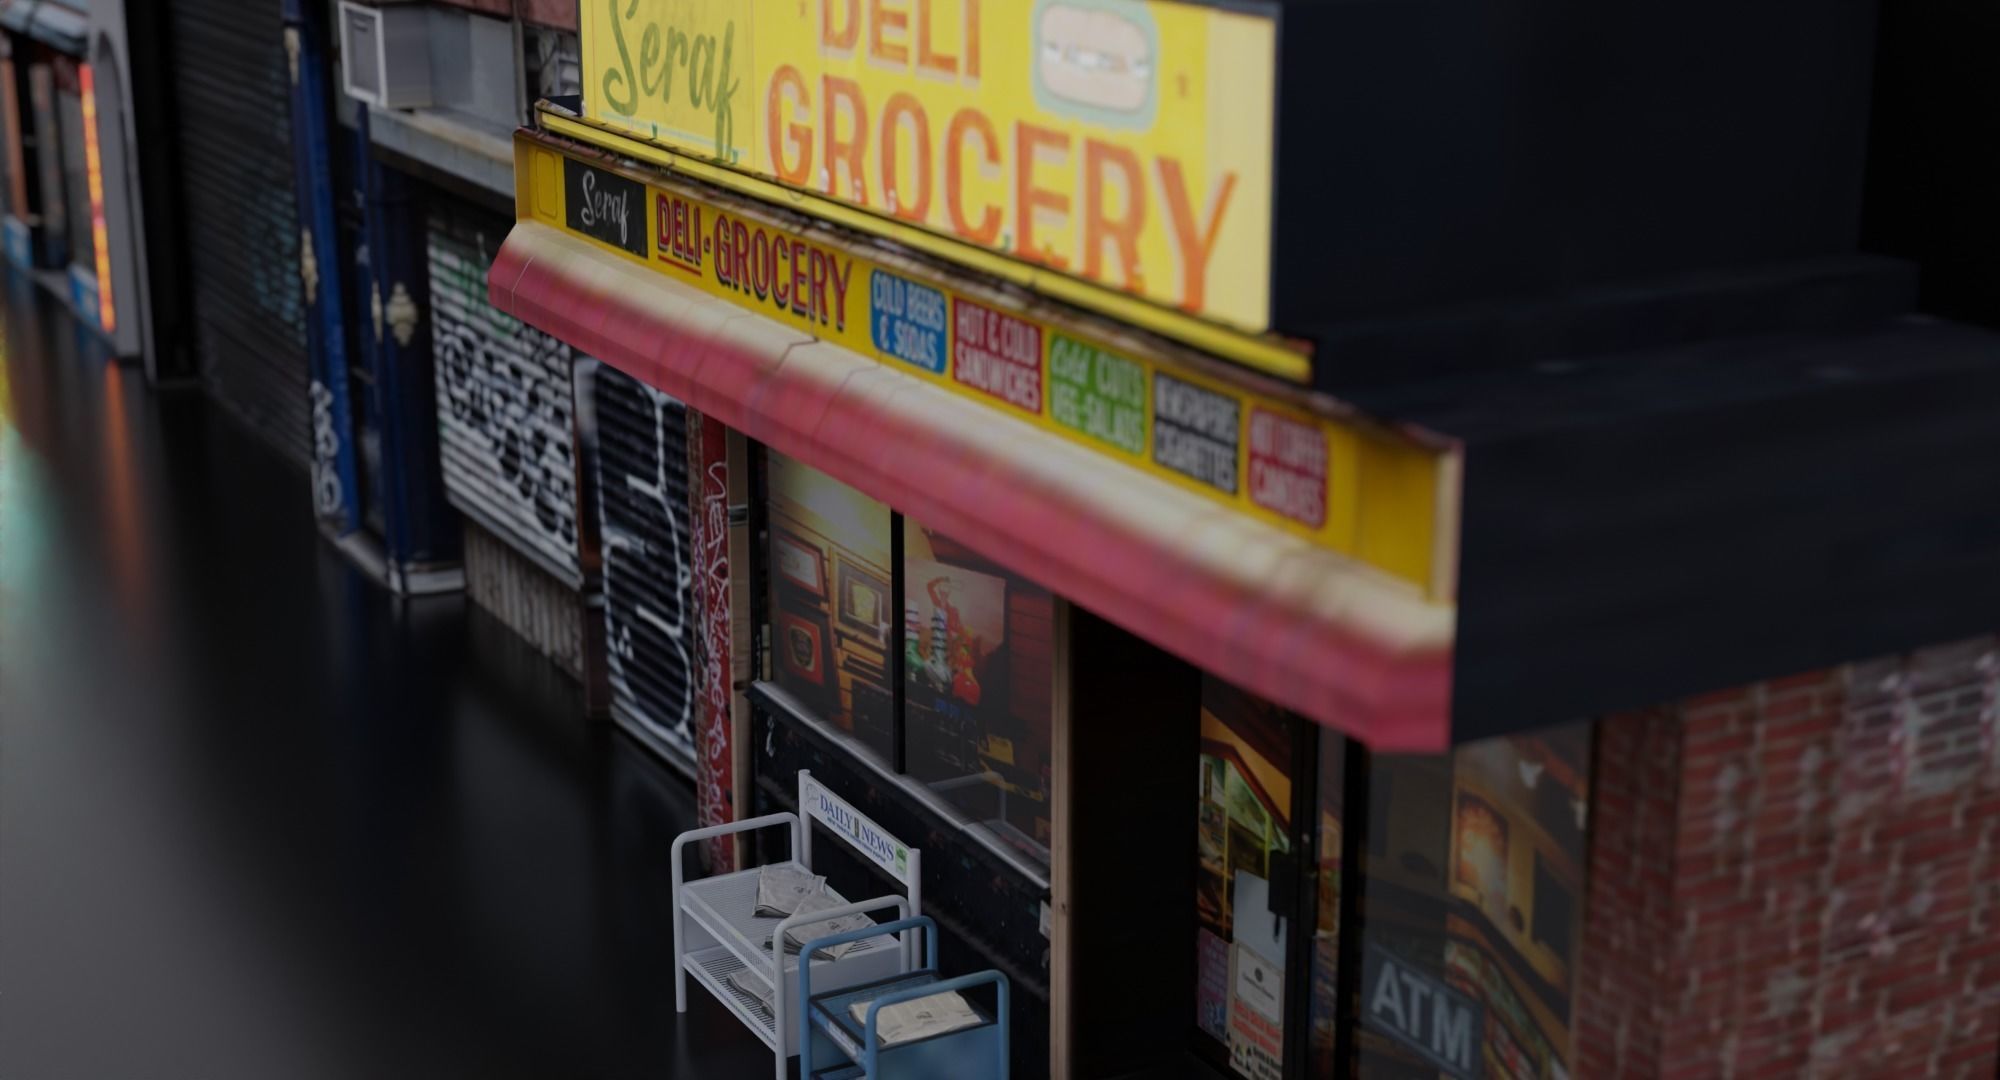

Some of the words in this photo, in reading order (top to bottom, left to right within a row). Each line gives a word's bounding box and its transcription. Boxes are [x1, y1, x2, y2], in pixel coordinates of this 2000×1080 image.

[602, 0, 739, 163] Seraf
[581, 170, 630, 244] Seraf
[767, 64, 1237, 314] GROCERY
[872, 270, 905, 317] COLD
[893, 319, 939, 371] SODAS
[820, 793, 853, 830] DAILY
[861, 823, 894, 861] NEWS
[1370, 959, 1473, 1071] ATM
